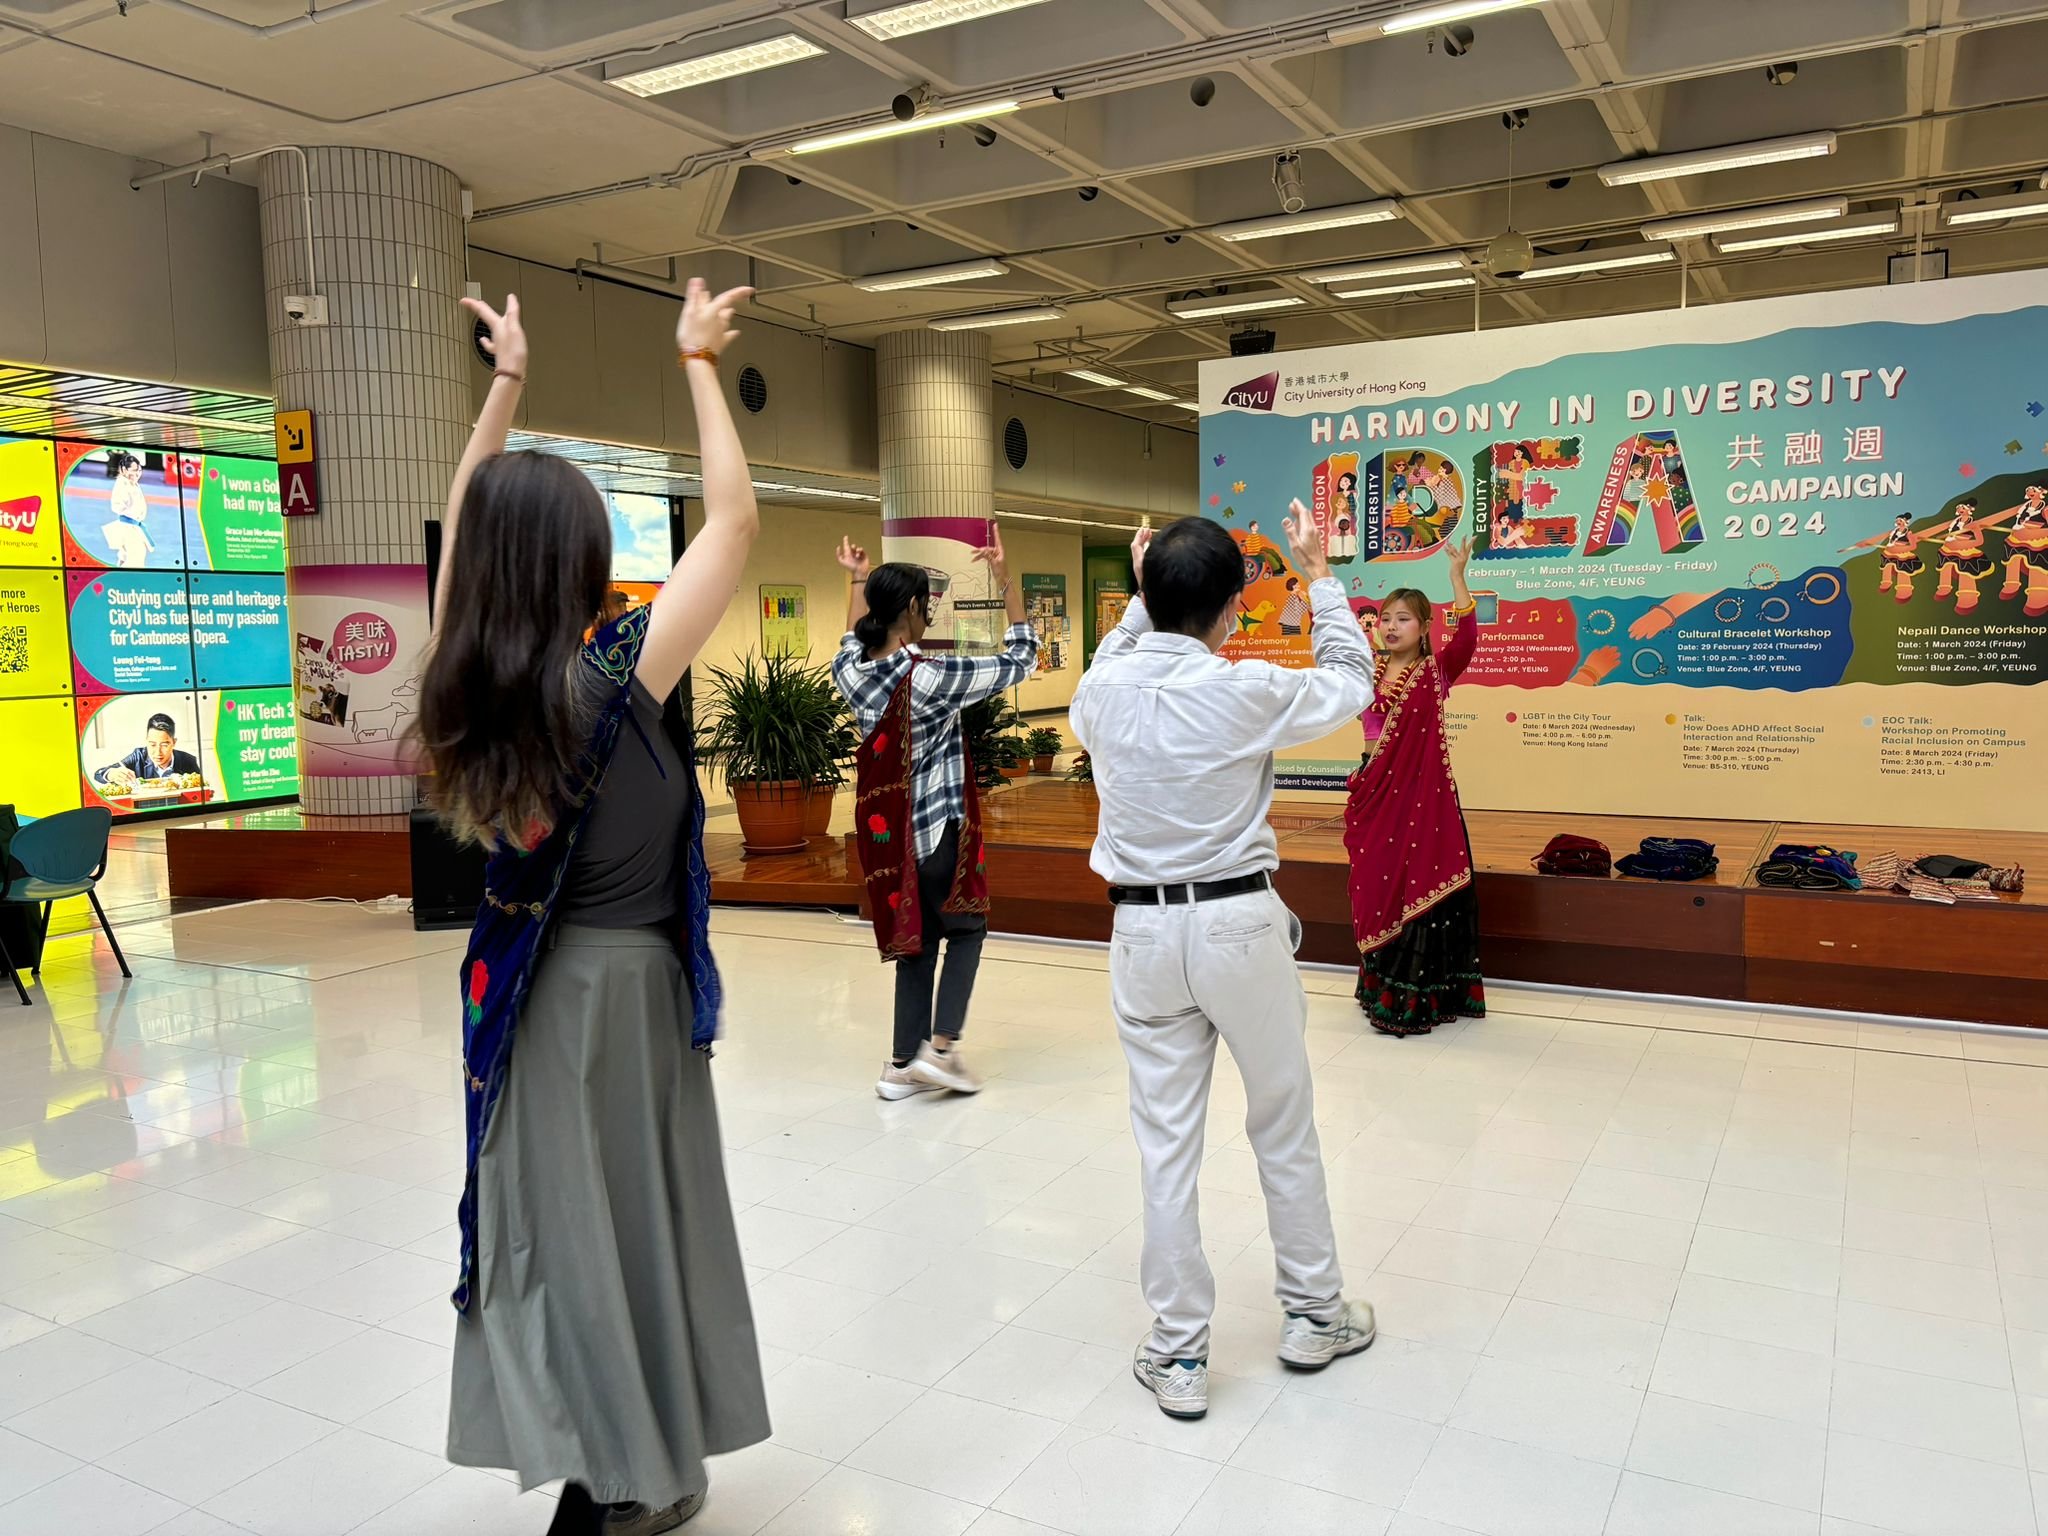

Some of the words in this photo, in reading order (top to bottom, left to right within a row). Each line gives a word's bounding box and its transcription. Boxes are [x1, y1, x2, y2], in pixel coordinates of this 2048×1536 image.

[1284, 371, 1350, 388] 香港城市大學
[1284, 391, 1304, 402] City
[1307, 384, 1355, 400] University
[1356, 384, 1366, 394] of
[1369, 382, 1396, 394] Hong
[1400, 380, 1426, 391] Kong
[1228, 390, 1269, 406] CityU
[1311, 400, 1522, 444] HARMONY
[1549, 394, 1595, 425] IN
[1626, 366, 1907, 420] DIVERSITY
[222, 474, 227, 490] I
[228, 479, 252, 492] won
[253, 481, 261, 492] a
[1726, 471, 1905, 505] CAMPAIGN
[288, 473, 310, 507] A
[1590, 446, 1629, 543] AWARENESS
[223, 494, 245, 510] had
[248, 499, 265, 515] my
[1476, 478, 1487, 533] EQUITY
[1368, 473, 1379, 549] DIVERSITY
[1723, 510, 1827, 540] 2024
[1468, 567, 1517, 578] February
[1539, 565, 1574, 575] March
[1577, 564, 1606, 574] 2024
[1608, 562, 1663, 574] (Tuesday
[1674, 560, 1718, 572] Friday)
[1515, 579, 1541, 589] Blue
[1543, 579, 1576, 589] Zone,
[1579, 578, 1599, 588] 4/F,
[1602, 576, 1646, 587] YEUNG
[1, 590, 26, 599] more
[107, 588, 161, 608] Studying
[164, 589, 207, 606] culture
[212, 591, 233, 607] and
[236, 591, 280, 609] heritage
[7, 602, 40, 613] Heroes
[109, 608, 142, 629] CityU
[145, 609, 167, 625] has
[169, 610, 214, 625] fuelled
[217, 613, 234, 628] my
[237, 610, 279, 628] passion
[345, 619, 386, 642] 美味
[1677, 629, 1721, 639] Cultural
[1723, 629, 1772, 638] Bracelet
[1774, 628, 1832, 639] Workshop
[1898, 626, 1937, 637] Nepali
[1940, 626, 1980, 635] Dance
[1983, 625, 2047, 636] Workshop
[110, 629, 128, 646] for
[130, 630, 189, 645] Cantonese
[193, 630, 229, 647] Opera.
[1248, 637, 1290, 646] Ceremony
[1482, 632, 1544, 642] Performance
[1526, 645, 1574, 653] (Wednesday)
[1677, 643, 1699, 651] Date:
[1713, 642, 1750, 651] February
[1752, 642, 1773, 650] 2024
[1775, 642, 1822, 651] (Thursday)
[1932, 640, 1961, 648] March
[1963, 640, 1987, 648] 2024
[1988, 640, 2026, 649] (Friday)
[337, 642, 390, 661] TASTY!
[1947, 653, 1967, 661] p.m.
[1977, 652, 1998, 660] 3:00
[2000, 653, 2021, 661] p.m.
[1677, 654, 1699, 662] Time:
[1769, 654, 1787, 662] p.m.
[1485, 666, 1505, 674] Zone,
[1676, 665, 1704, 673] Venue:
[1727, 665, 1750, 673] Zone,
[1896, 664, 1928, 672] Venue:
[1930, 664, 1951, 672] Blue
[1953, 664, 1980, 672] Zone,
[1982, 664, 1999, 672] 4/F,
[237, 704, 255, 721] HK
[257, 703, 285, 719] Tech
[1445, 712, 1479, 720] Sharing:
[1557, 713, 1571, 721] the
[1573, 713, 1590, 722] City
[1684, 714, 1705, 722] Talk:
[1882, 716, 1905, 724] EOC
[1908, 716, 1932, 725] Talk:
[1590, 724, 1636, 732] (Wednesday)
[1683, 724, 1703, 732] How
[1706, 724, 1729, 732] Does
[1731, 724, 1760, 732] ADHD
[1762, 725, 1792, 733] Affect
[1794, 725, 1825, 733] Social
[1881, 726, 1933, 736] Workshop
[1951, 727, 2006, 737] Promoting
[239, 729, 259, 745] my
[1683, 734, 1733, 742] Interaction
[1736, 734, 1753, 742] and
[1756, 734, 1815, 743] Relationship
[1881, 736, 1914, 744] Racial
[1916, 737, 1964, 746] Inclusion
[1982, 738, 2026, 748] Campus
[240, 747, 265, 764] stay
[1757, 746, 1800, 754] (Thursday)
[1964, 750, 1998, 758] (Friday)
[1296, 765, 1306, 774] by
[1307, 766, 1352, 774] Counselling
[1911, 768, 1935, 776] 2413,
